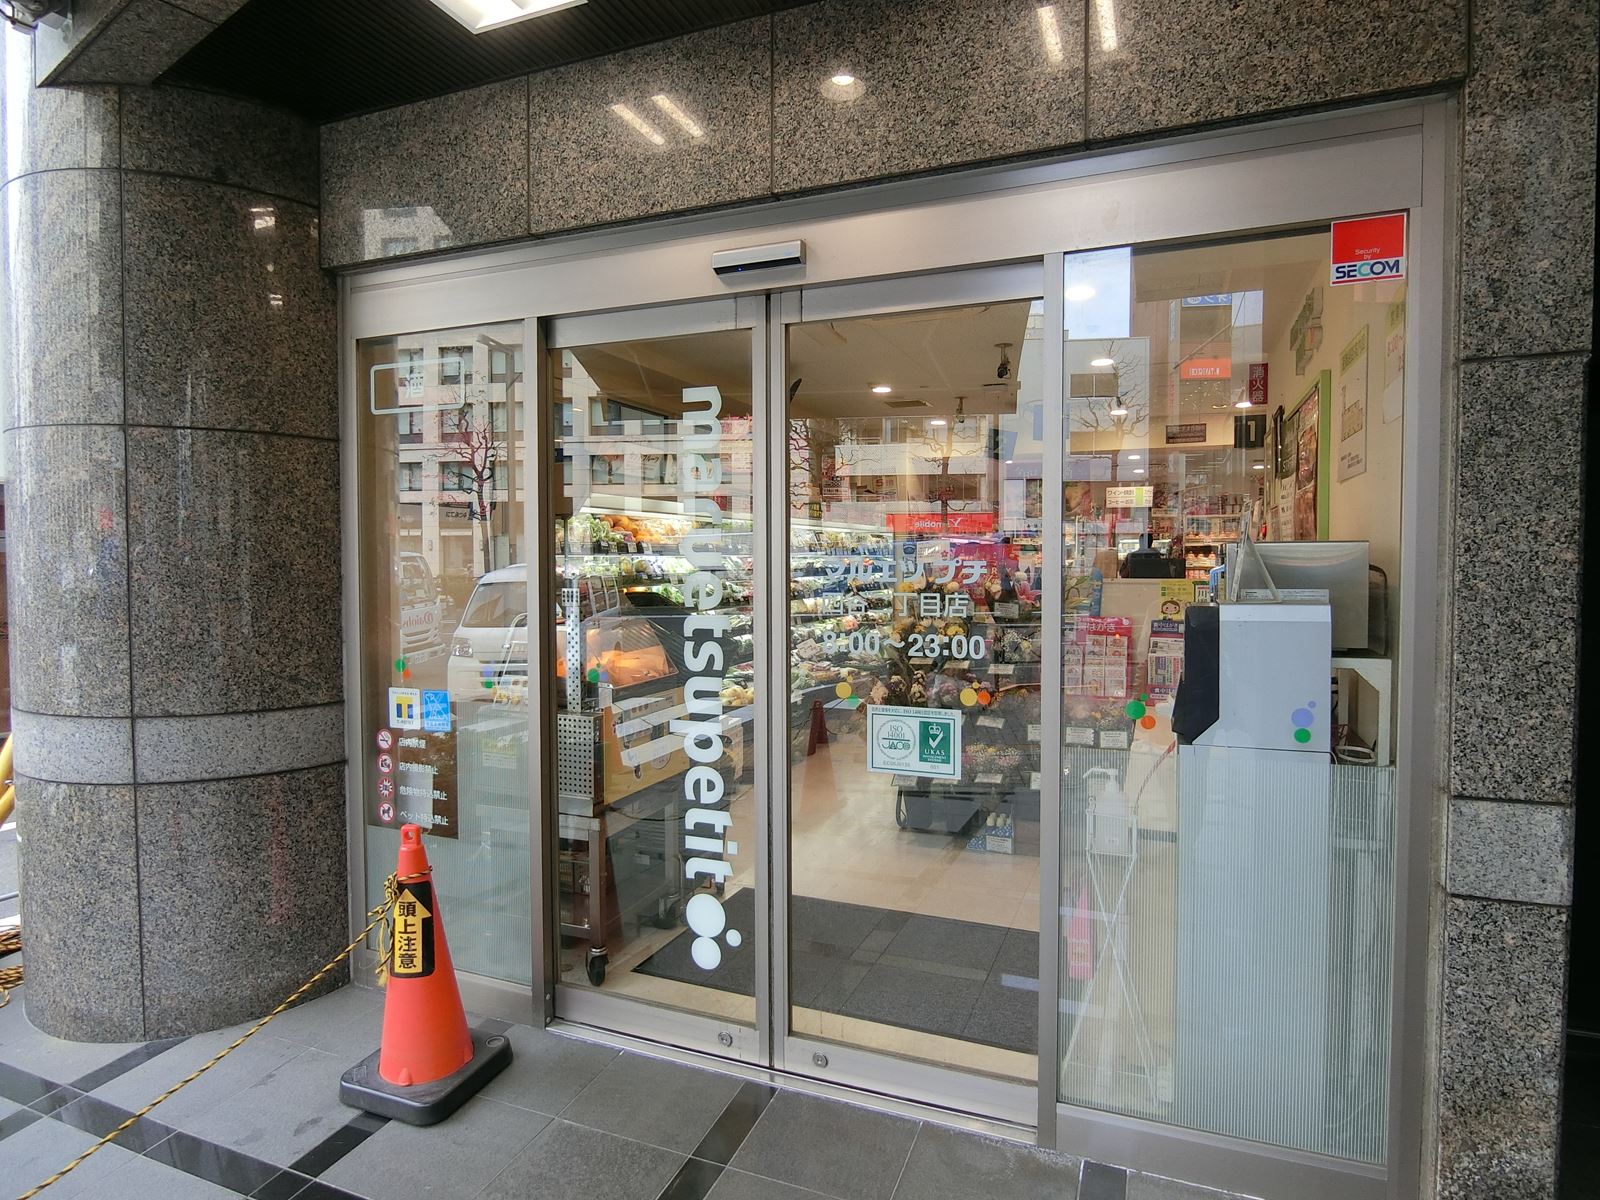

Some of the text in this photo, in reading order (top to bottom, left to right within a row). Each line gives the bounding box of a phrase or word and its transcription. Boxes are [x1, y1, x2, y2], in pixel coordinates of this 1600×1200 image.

[1354, 247, 1381, 256] Security
[1335, 259, 1400, 280] SECOM
[1252, 366, 1265, 402] 消火器
[1247, 420, 1256, 442] 1
[822, 592, 970, 618] 四谷丁目店
[889, 724, 903, 732] ISO
[398, 901, 417, 969] 頭上注意
